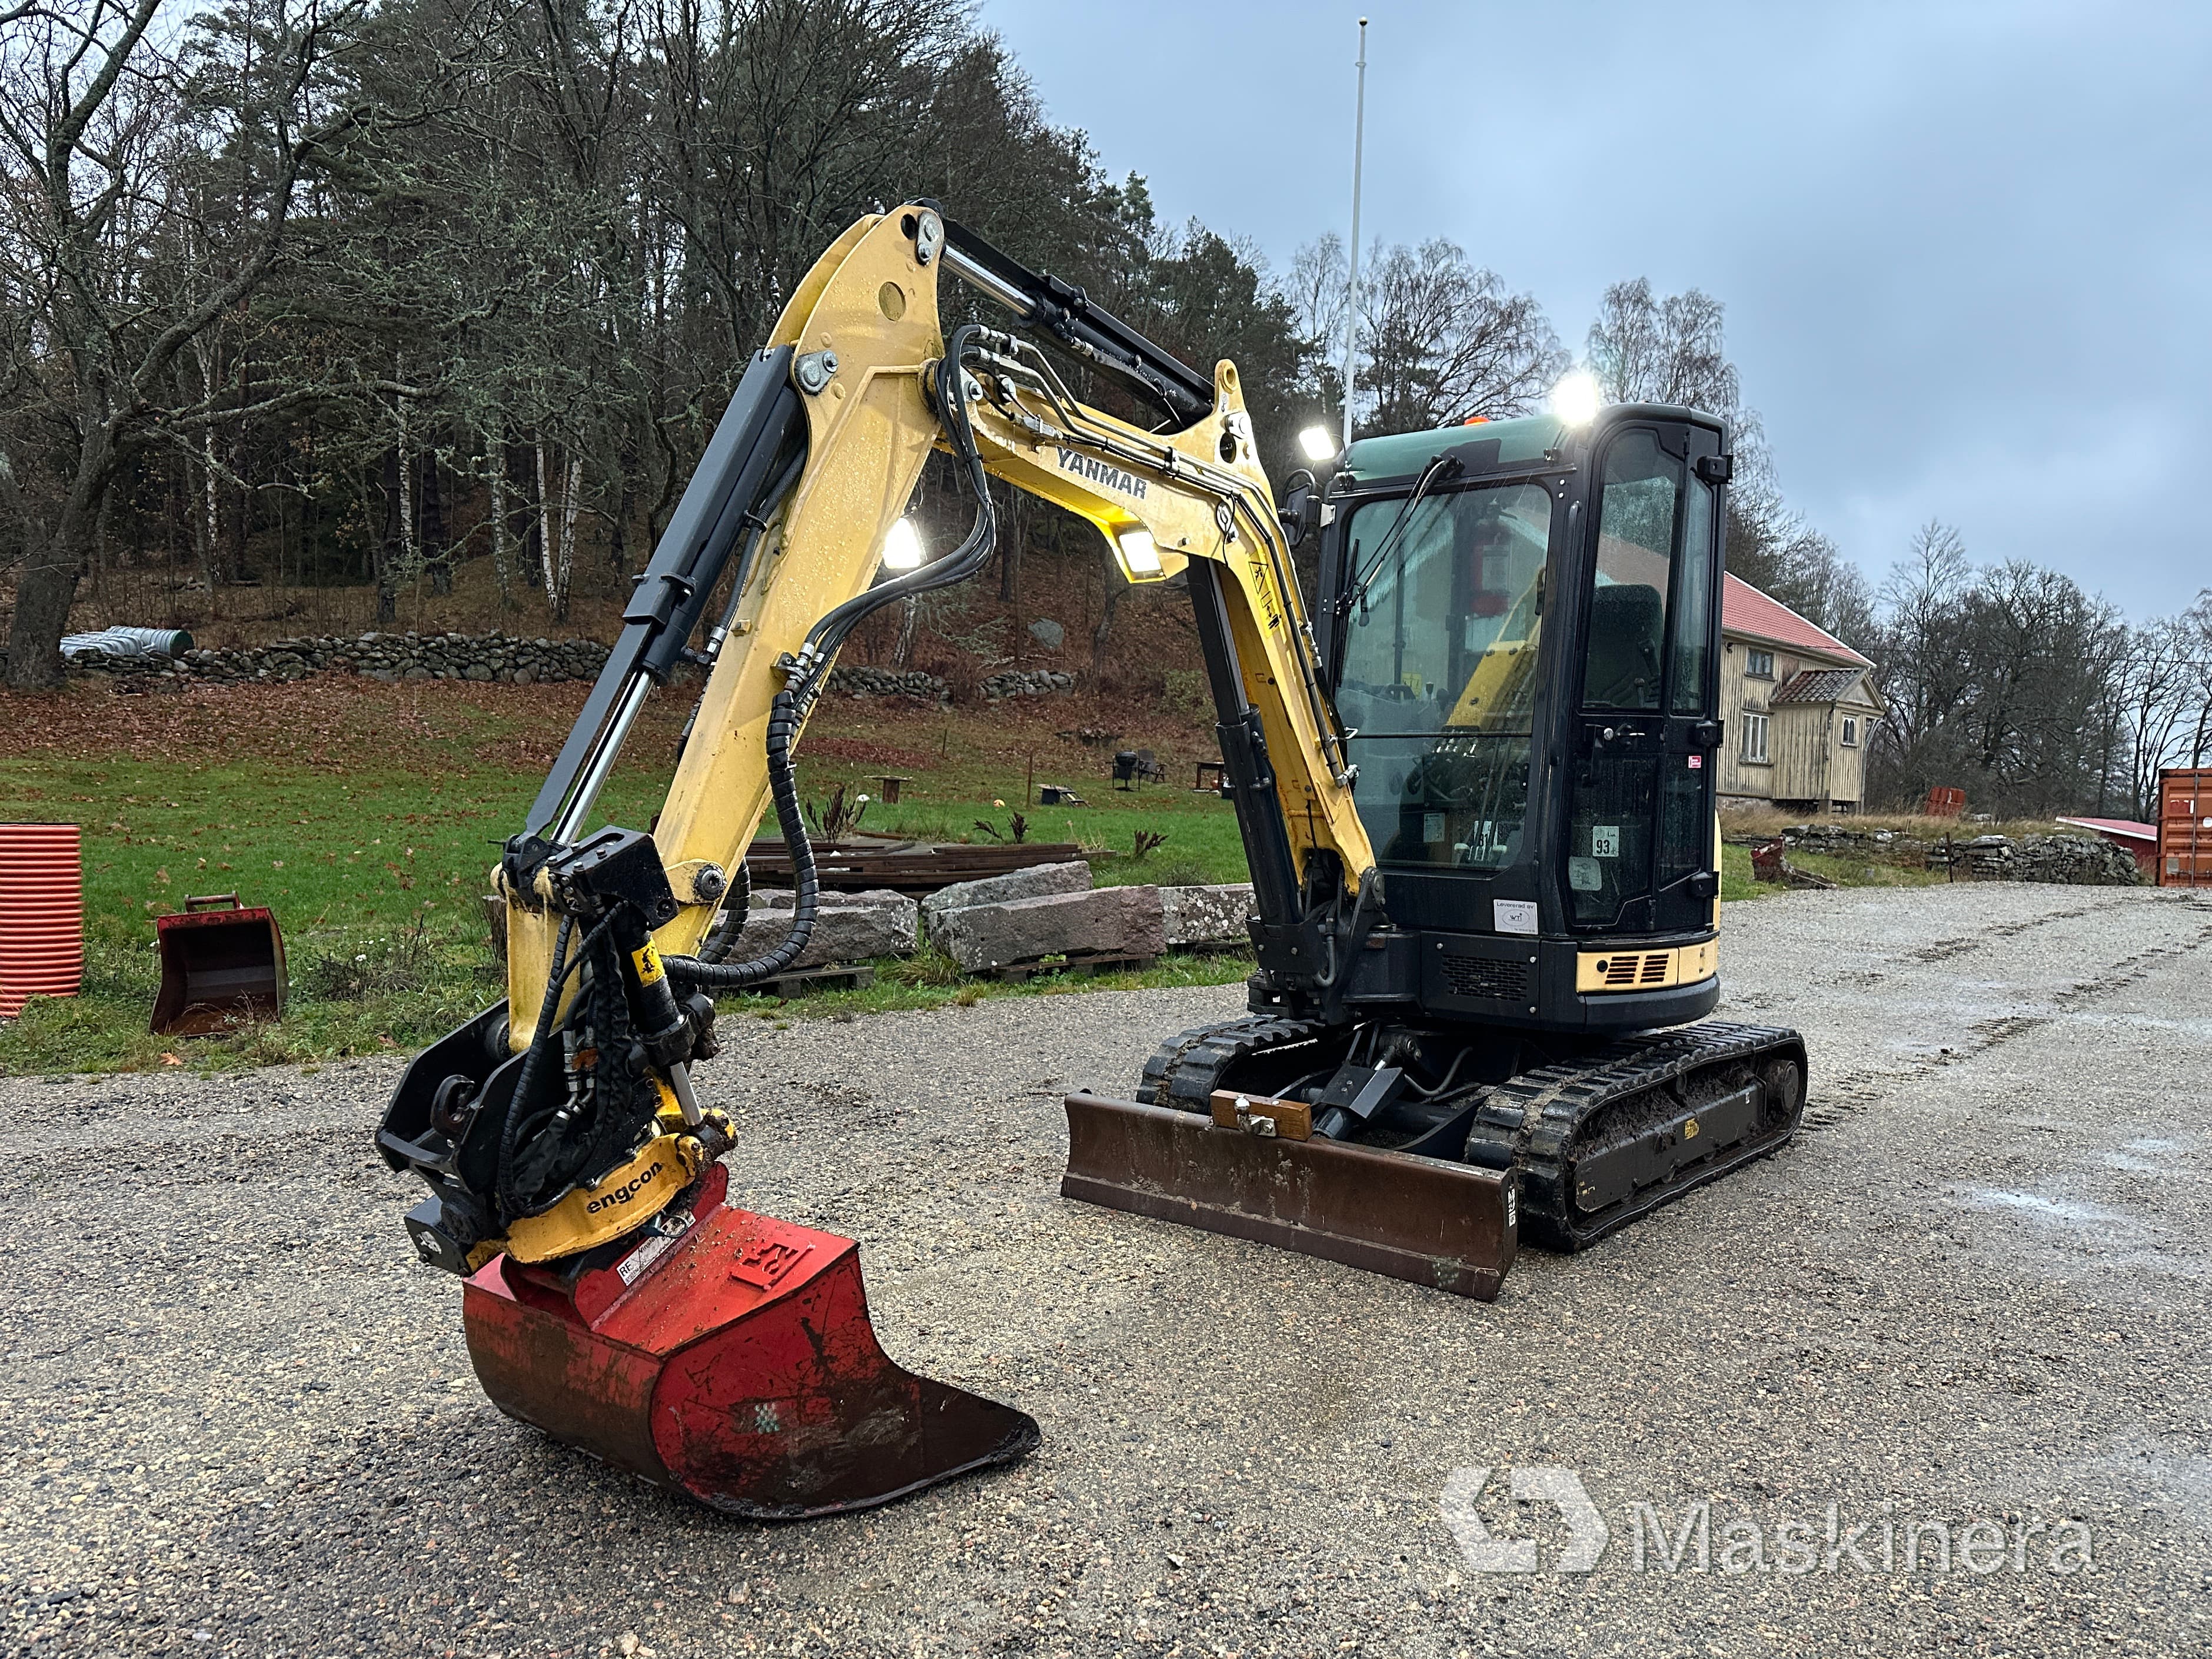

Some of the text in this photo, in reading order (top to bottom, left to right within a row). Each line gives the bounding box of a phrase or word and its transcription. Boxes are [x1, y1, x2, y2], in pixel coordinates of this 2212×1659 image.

[1056, 445, 1147, 500] YANMAR
[1596, 839, 1610, 854] 93
[586, 1161, 663, 1214] engcon
[619, 1261, 631, 1276] RF
